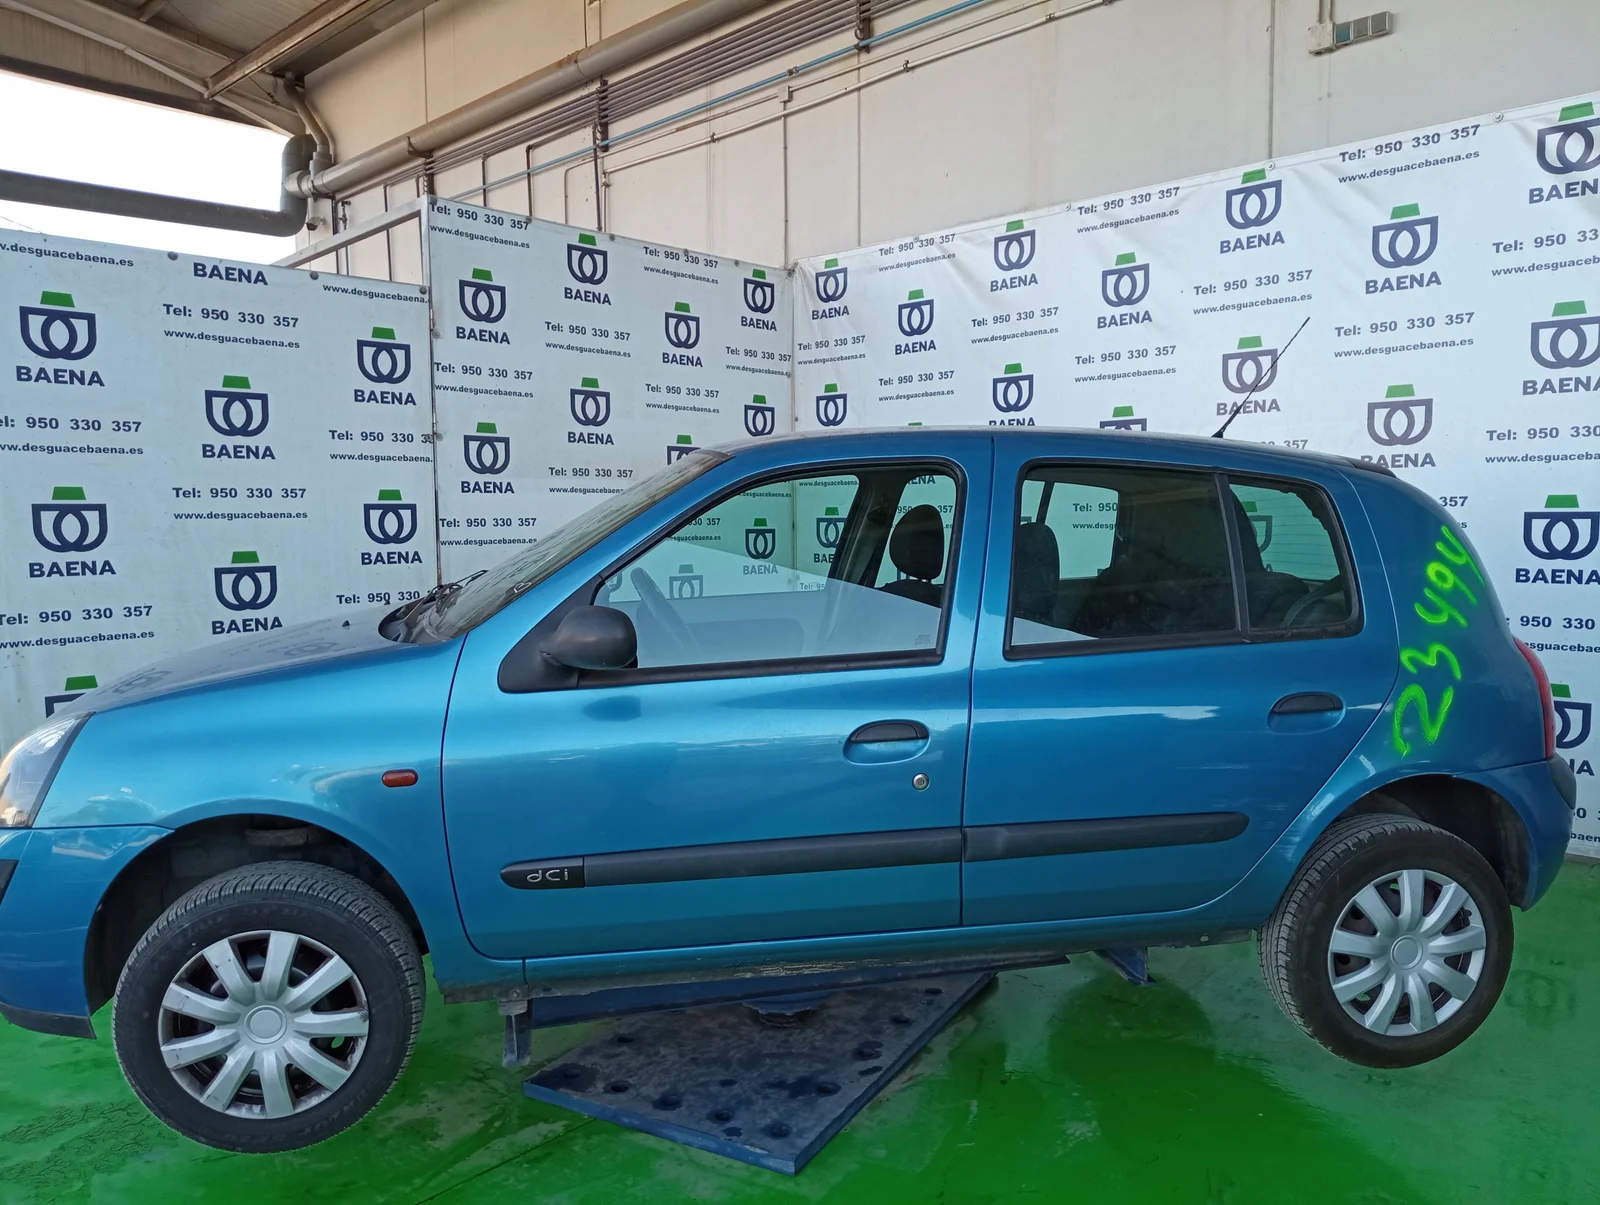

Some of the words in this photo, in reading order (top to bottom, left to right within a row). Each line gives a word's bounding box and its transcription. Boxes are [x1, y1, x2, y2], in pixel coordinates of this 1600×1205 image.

[1339, 149, 1365, 162] Tel:
[1375, 141, 1402, 155] 950
[1412, 133, 1440, 148] 330
[1451, 124, 1480, 140] 357
[1338, 152, 1480, 183] www.desguacebaena.es
[1529, 178, 1598, 204] BAEN
[1078, 204, 1097, 215] Tel:
[1103, 199, 1123, 210] 950
[1131, 193, 1151, 205] 330
[1158, 187, 1180, 199] 357
[430, 203, 451, 216] Tel:
[457, 208, 478, 221] 950
[484, 213, 504, 226] 330
[510, 218, 530, 231] 357
[1077, 209, 1180, 233] www.desguacebaena.es
[430, 224, 530, 248] www.desguacebaena.es
[879, 247, 894, 256] Tel:
[898, 242, 914, 252] 950
[917, 237, 934, 248] 330
[940, 233, 956, 244] 357
[1220, 231, 1285, 254] BAENA
[1493, 240, 1523, 253] Tel:
[1534, 234, 1566, 248] 950
[643, 246, 660, 258] Tel:
[664, 250, 680, 261] 950
[684, 254, 700, 265] 330
[704, 258, 719, 269] 357
[879, 252, 956, 272] www.desguacebaena.es
[194, 262, 268, 285] BAENA
[1194, 284, 1216, 295] Tel:
[1224, 279, 1247, 291] 950
[1256, 274, 1279, 286] 330
[1288, 269, 1312, 282] 357
[990, 273, 1038, 292] BAENA
[1366, 271, 1441, 294] BAENA
[565, 287, 611, 305] BAENA
[1193, 292, 1313, 315] www.desguacebaena.es
[163, 304, 191, 317] Tel:
[201, 308, 229, 320] 950
[238, 312, 264, 324] 330
[273, 316, 298, 327] 357
[812, 306, 849, 320] BAENA
[972, 318, 987, 327] Tel:
[993, 314, 1010, 324] 950
[1017, 311, 1034, 321] 330
[1040, 307, 1059, 317] 357
[1098, 310, 1152, 329] BAENA
[545, 322, 563, 332] Tel:
[569, 325, 586, 335] 950
[592, 328, 609, 338] 330
[614, 331, 630, 340] 357
[741, 316, 777, 331] BAENA
[1335, 325, 1361, 337] Tel:
[1370, 321, 1397, 333] 950
[1407, 317, 1435, 329] 330
[1445, 312, 1474, 325] 357
[164, 330, 300, 348] www.desguacebaena.es
[456, 326, 510, 344] BAENA
[815, 340, 829, 349] 950
[834, 338, 847, 347] 330
[852, 335, 865, 344] 357
[971, 327, 1059, 344] www.desguacebaena.es
[545, 343, 631, 357] www.desguacebaena.es
[726, 346, 740, 356] Tel:
[743, 349, 758, 359] 950
[762, 351, 777, 362] 330
[779, 353, 792, 363] 357
[895, 340, 936, 355] BAENA
[1075, 355, 1094, 365] Tel:
[1101, 352, 1121, 362] 950
[1128, 349, 1148, 359] 330
[1155, 345, 1176, 356] 357
[1334, 339, 1474, 357] www.desguacebaena.es
[663, 352, 703, 367] BAENA
[798, 354, 865, 365] www.desguacebaena.es
[16, 366, 105, 386] BAENA
[434, 362, 456, 375] Tel:
[461, 365, 483, 377] 950
[488, 367, 509, 380] 330
[513, 370, 533, 381] 357
[879, 378, 893, 386] Tel:
[898, 375, 913, 384] 950
[918, 373, 933, 382] 330
[939, 371, 954, 380] 357
[1075, 368, 1176, 382] www.desguacebaena.es
[354, 389, 416, 405] BAENA
[434, 383, 534, 399] www.desguacebaena.es
[645, 384, 661, 392] Tel:
[666, 386, 681, 394] 950
[686, 388, 700, 396] 330
[704, 390, 719, 398] 357
[879, 390, 954, 401] www.desguacebaena.es
[646, 403, 719, 413] www.desguacebaena.es
[1216, 398, 1281, 416] BAENA
[26, 417, 59, 429] 950
[70, 419, 101, 431] 330
[112, 421, 141, 432] 357
[329, 429, 353, 441] Tel:
[361, 431, 385, 443] 950
[391, 431, 415, 444] 330
[568, 432, 614, 445] BAENA
[1486, 429, 1516, 441] Tel:
[1528, 427, 1559, 439] 950
[202, 444, 276, 459] BAENA
[549, 467, 567, 477] Tel:
[572, 468, 590, 478] 950
[594, 468, 612, 478] 330
[617, 469, 634, 479] 357
[172, 488, 201, 498] Tel:
[210, 488, 237, 498] 950
[247, 488, 272, 498] 330
[282, 488, 306, 498] 357
[461, 481, 514, 493] BAENA
[1073, 503, 1092, 512] Tel:
[1440, 496, 1468, 507] 357
[174, 511, 307, 521] www.desguacebaena.es
[439, 518, 460, 529] Tel:
[466, 517, 487, 529] 950
[493, 517, 512, 528] 330
[518, 517, 537, 528] 357
[706, 517, 721, 527] 357
[361, 551, 422, 565] BAENA
[29, 560, 116, 578] BAENA
[743, 564, 778, 575] BAENA
[1516, 568, 1600, 585] BAENA
[336, 594, 361, 605] Tel:
[368, 592, 391, 603] 950
[398, 590, 420, 602] 330
[39, 610, 71, 623] 950
[82, 608, 113, 620] 330
[123, 606, 152, 617] 357
[1520, 616, 1552, 628] 950
[1562, 617, 1596, 630] 330
[212, 617, 283, 635] BAENA
